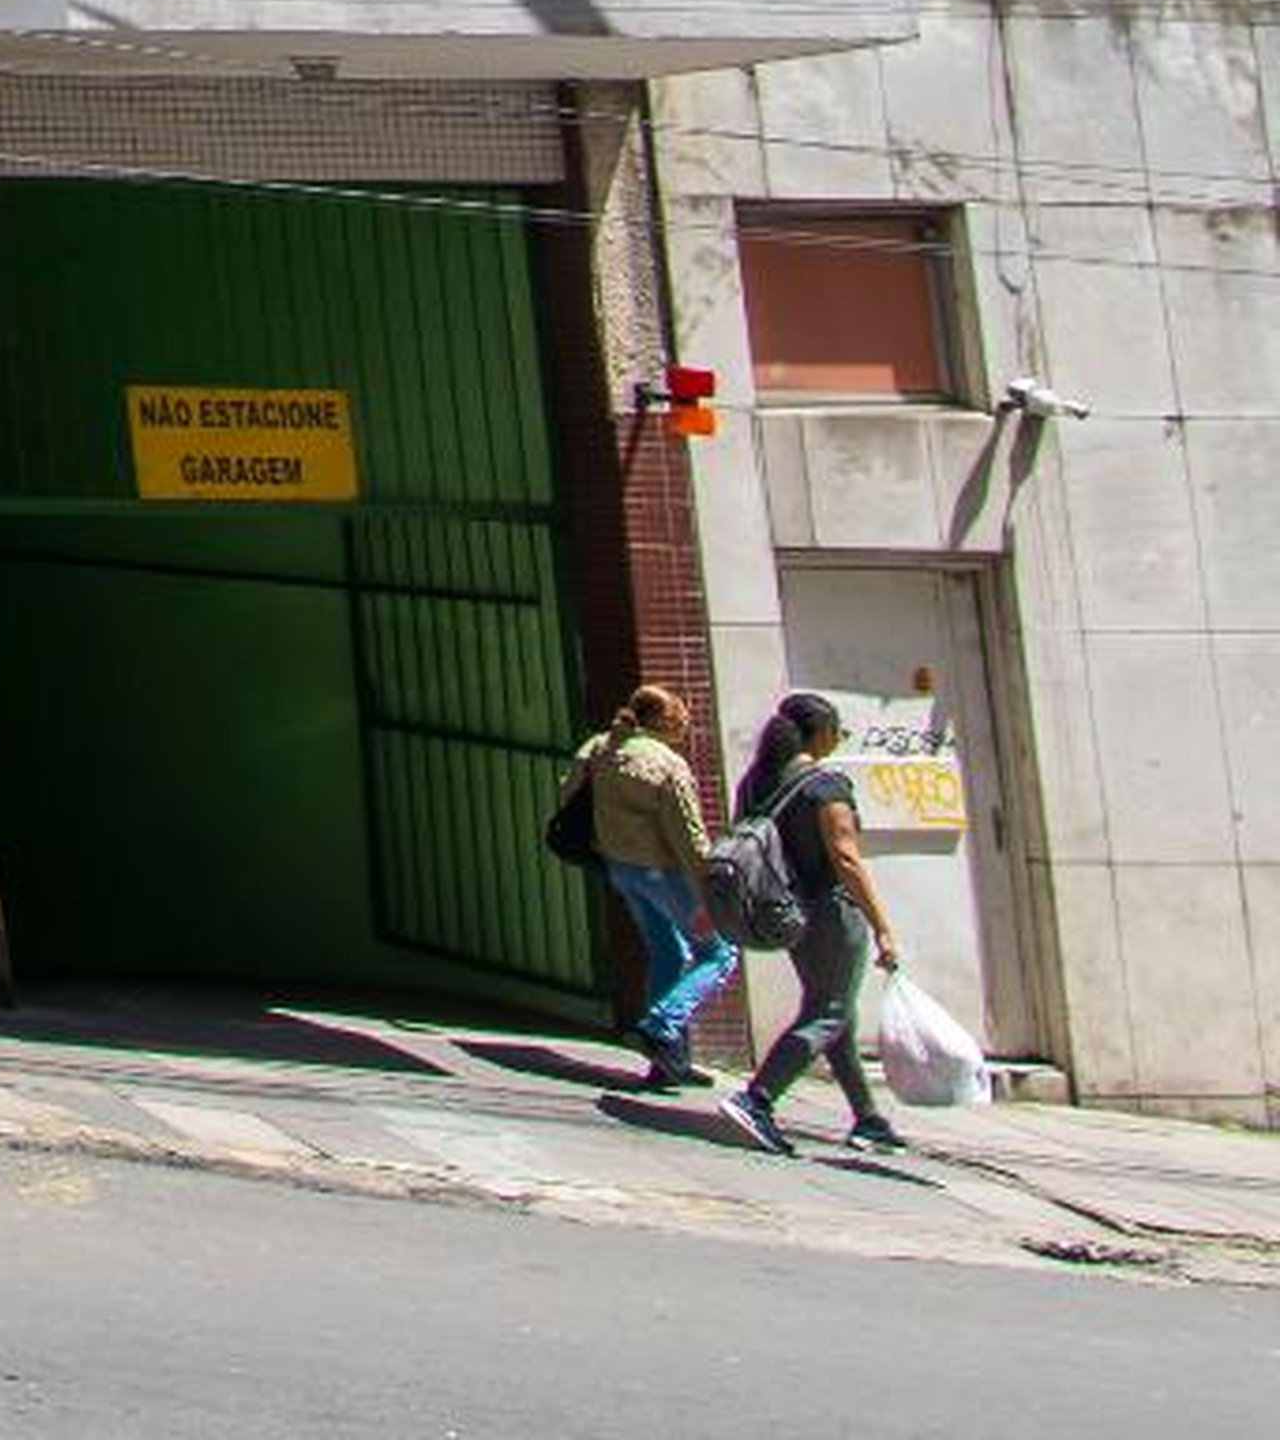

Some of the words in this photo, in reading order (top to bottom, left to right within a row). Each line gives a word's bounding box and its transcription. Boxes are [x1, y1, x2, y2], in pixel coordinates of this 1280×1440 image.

[138, 395, 192, 428] NÃO
[198, 399, 340, 429] ESTACIONE
[179, 454, 303, 485] GARAGEM
